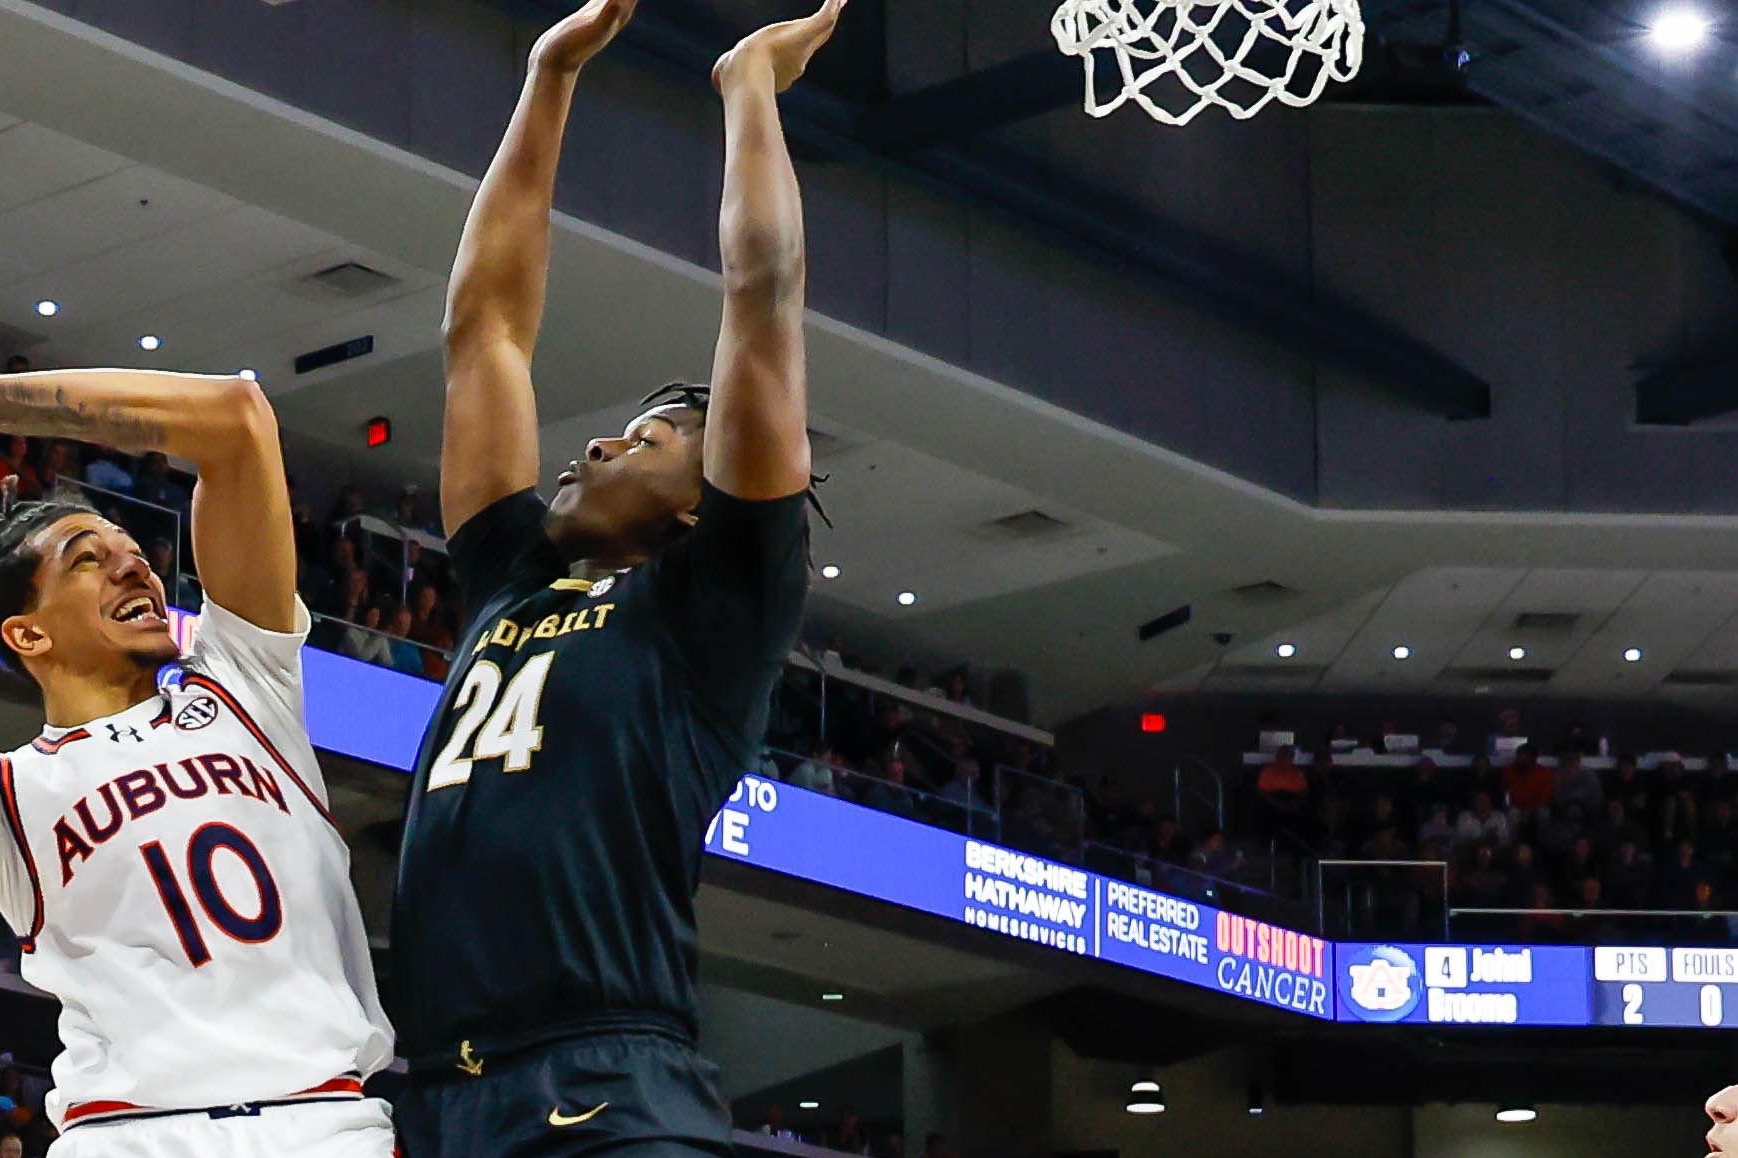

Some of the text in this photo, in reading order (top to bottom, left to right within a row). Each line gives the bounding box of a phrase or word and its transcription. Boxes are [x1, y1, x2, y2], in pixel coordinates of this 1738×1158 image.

[426, 650, 556, 792] 24
[744, 777, 777, 812] TO
[53, 753, 292, 888] AUBURN
[138, 821, 283, 969] 10
[965, 840, 1088, 899] BERKSHIRE
[965, 872, 1087, 929] HATHAWAY
[1107, 881, 1200, 930] PREFERRED
[964, 906, 1086, 955] HOMESERVICES
[1107, 911, 1209, 965] REAL ESTATE
[1216, 910, 1326, 978] OUTSHOOT
[1217, 956, 1327, 1015] CANCER
[1441, 955, 1452, 980] 4
[1616, 953, 1648, 975] PTS
[1683, 953, 1735, 976] FOULS
[1622, 983, 1644, 1025] 2
[1700, 984, 1723, 1026] 0
